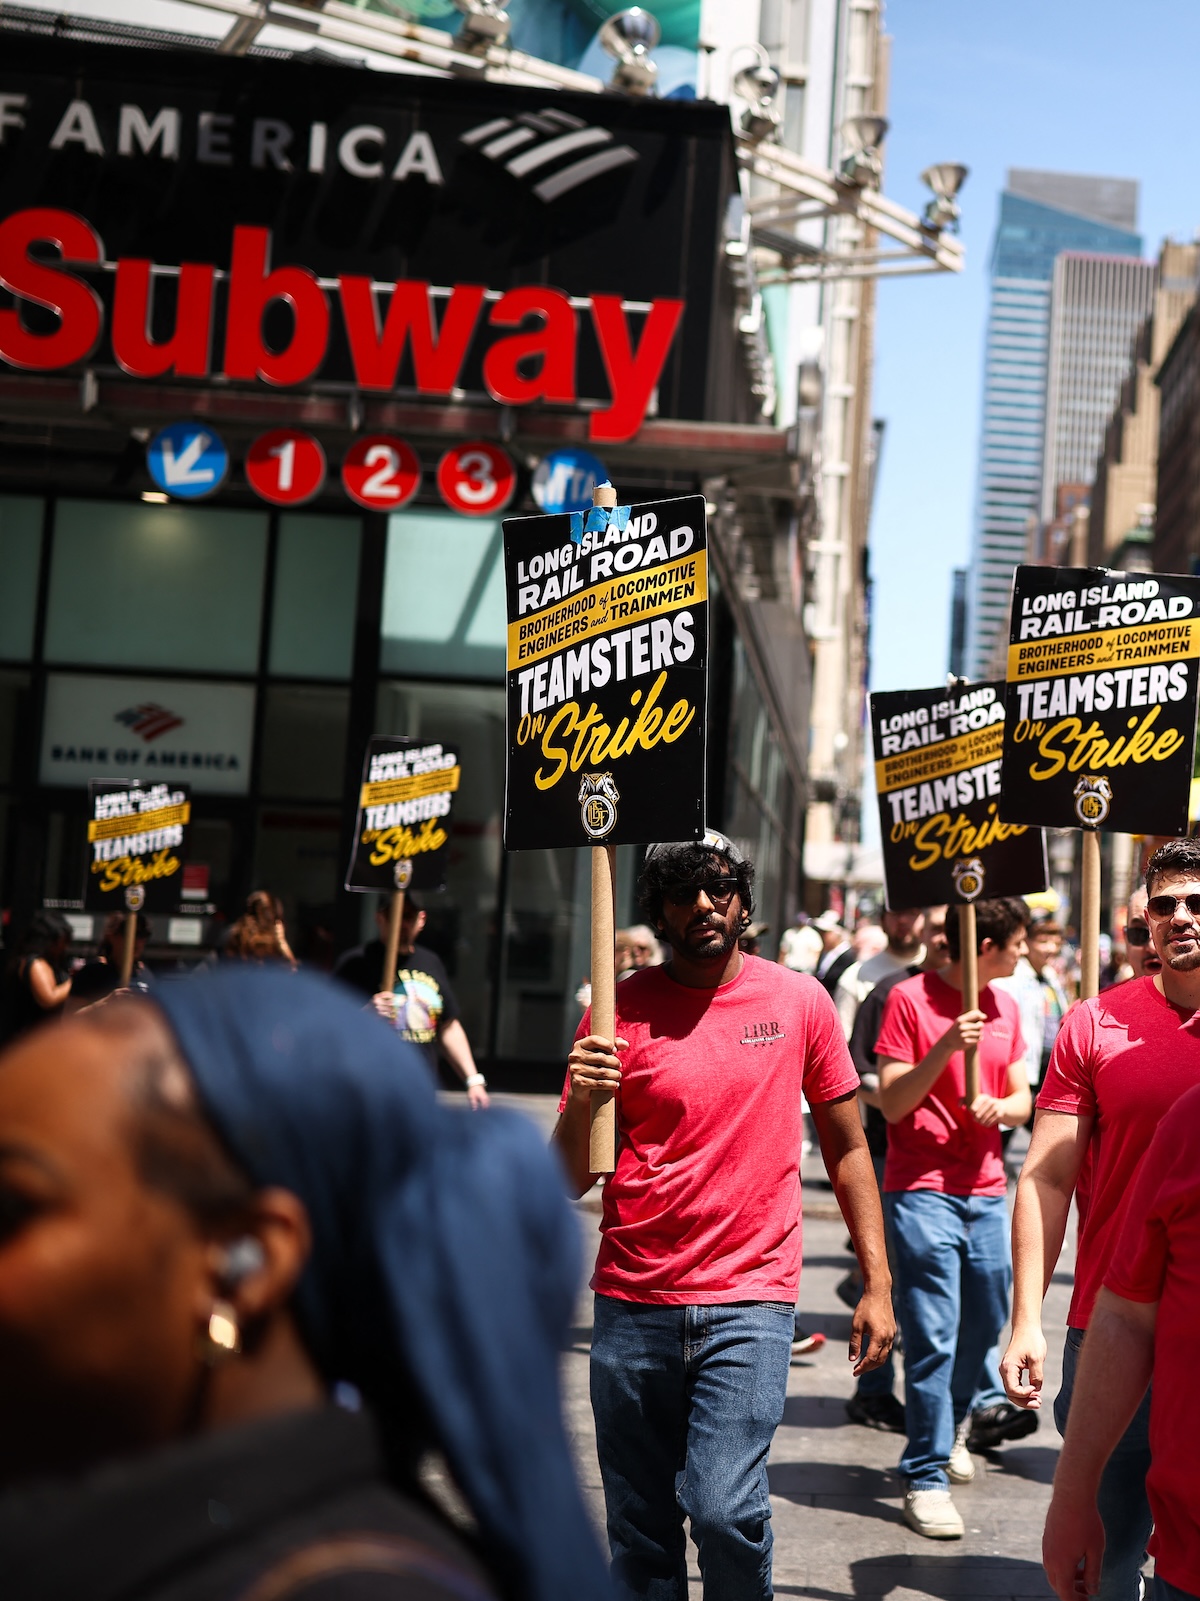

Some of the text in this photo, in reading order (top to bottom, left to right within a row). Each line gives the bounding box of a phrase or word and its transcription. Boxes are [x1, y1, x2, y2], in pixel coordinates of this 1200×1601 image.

[50, 99, 445, 186] AMERICA
[0, 208, 684, 442] Subway
[269, 438, 495, 504] 1 2 3
[517, 543, 572, 584] LONG
[518, 525, 694, 615] RAIL ROAD
[518, 581, 695, 660] ENGINEERS and TRAINMEN
[519, 560, 696, 641] BROTHERHOOD of LOCOMOTIVE
[1019, 596, 1193, 640] RAIL ROAD
[1022, 579, 1159, 616] LONG ISLAND
[518, 611, 695, 718] TEAMSTERS
[1017, 653, 1094, 675] ENGINEERS
[1115, 640, 1190, 661] TRAINMEN
[1019, 637, 1103, 660] BROTHERHOOD
[1117, 625, 1192, 646] LOCOMOTIVE
[880, 687, 996, 736] LONG ISLAND
[1017, 662, 1188, 721] TEAMSTERS
[517, 670, 696, 791] On Strike
[881, 701, 1006, 757] RAIL ROA
[885, 743, 957, 771] BROTHERHOOD
[969, 730, 1004, 748] LOCOM
[1013, 704, 1184, 781] On Strike
[51, 745, 240, 772] BANK OF AMERICA
[886, 760, 952, 787] ENGINEERS
[970, 743, 1003, 760] TRAIN
[366, 791, 452, 832] TEAMSTERS
[888, 762, 1003, 823] TEAMSTE
[370, 817, 448, 866] Strike
[890, 821, 917, 843] On
[744, 1021, 780, 1039] LIRR
